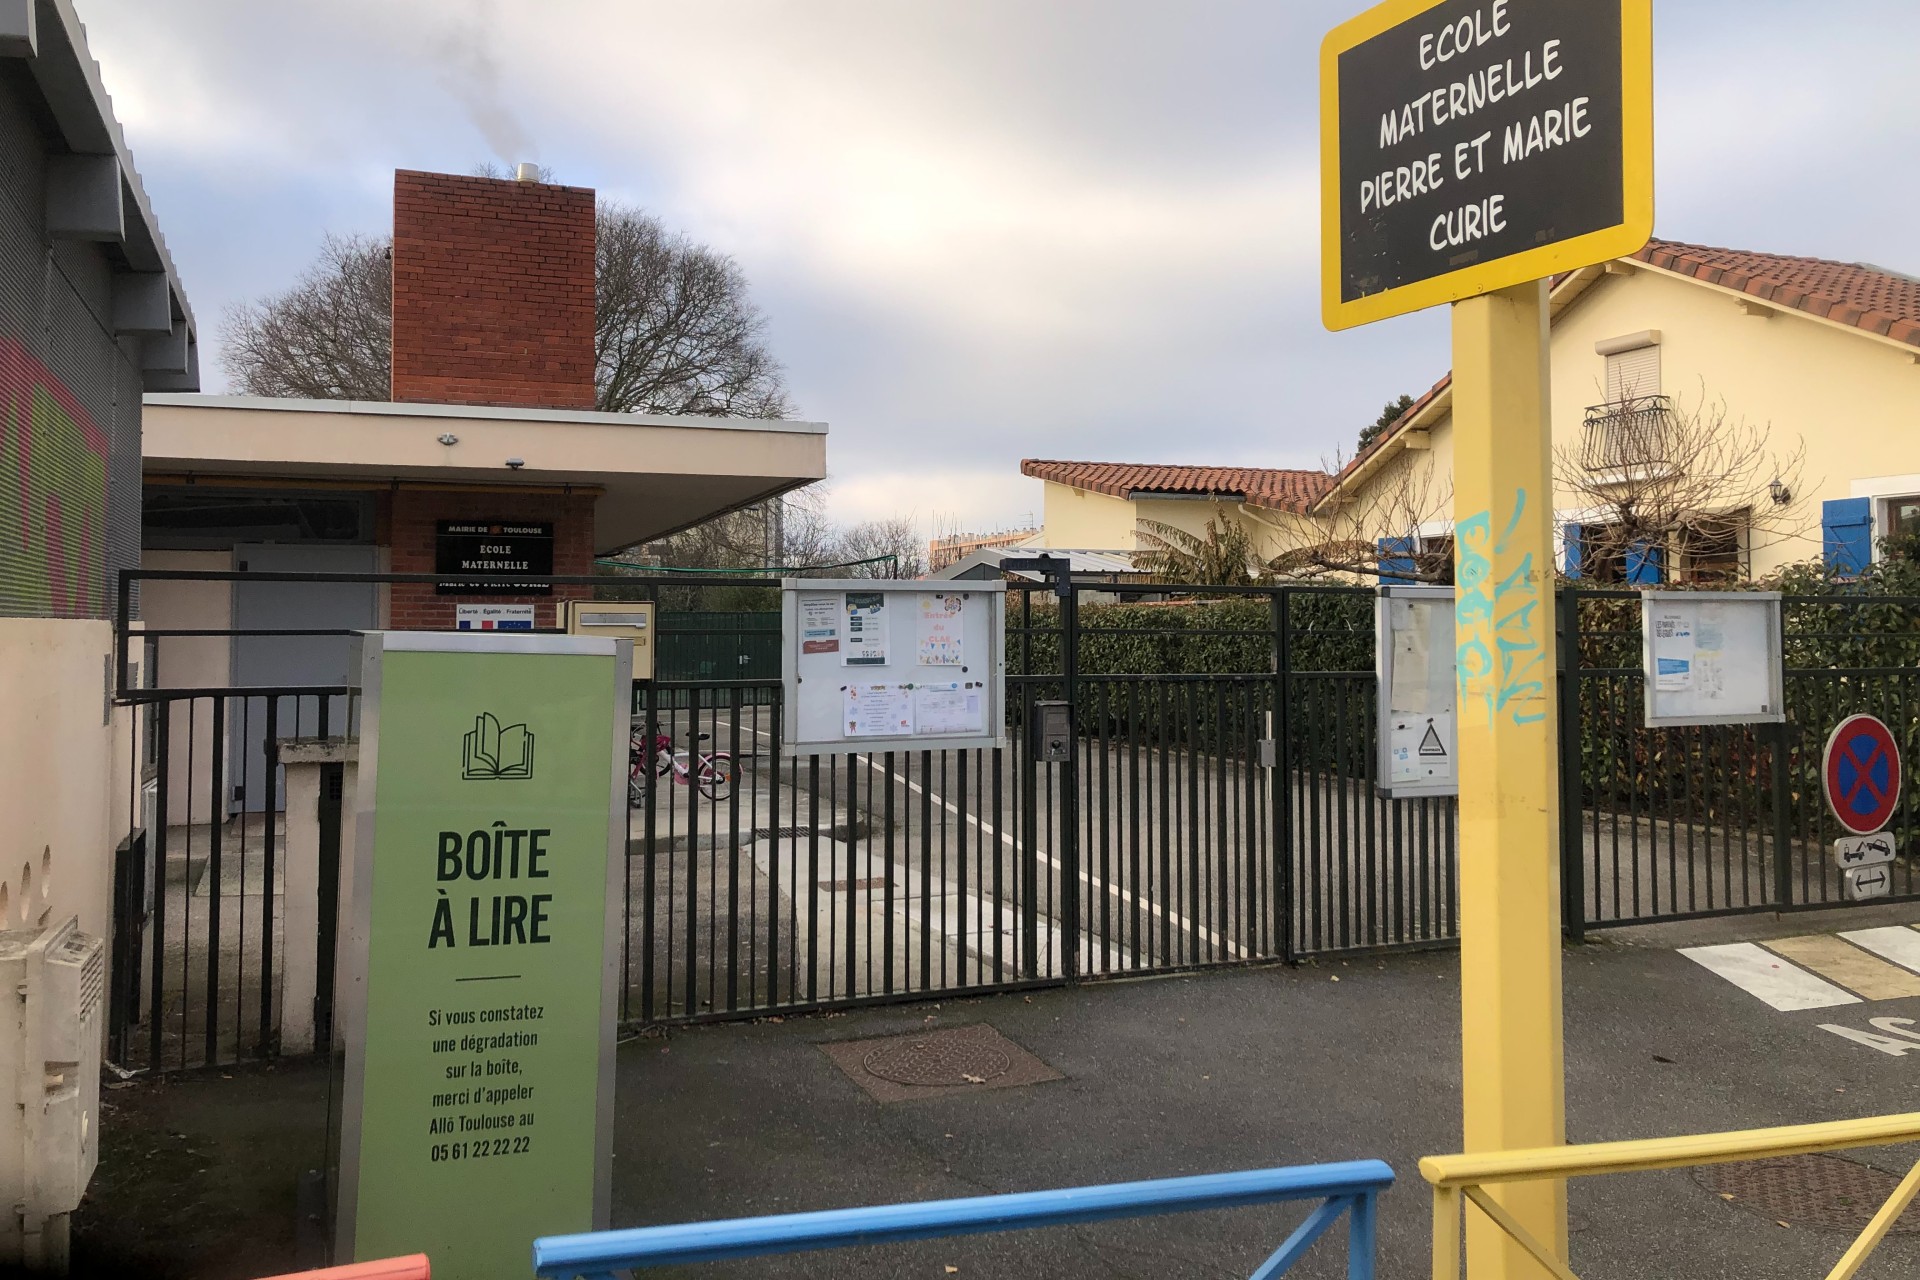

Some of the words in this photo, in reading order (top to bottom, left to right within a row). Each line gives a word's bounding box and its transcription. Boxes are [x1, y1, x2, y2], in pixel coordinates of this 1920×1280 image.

[1419, 0, 1511, 70] ECOLE
[1380, 39, 1562, 148] MATERNELLE
[1360, 153, 1443, 214] PIERRE
[1455, 132, 1492, 180] ET
[1504, 97, 1592, 164] MARIE
[1430, 194, 1506, 251] CURIE
[480, 545, 512, 554] ECOLE
[462, 560, 529, 570] MATERNELLE
[436, 820, 550, 882] BOÎTE
[428, 888, 456, 948] À
[469, 894, 552, 946] LIRE
[429, 1009, 441, 1026] Si
[446, 1012, 475, 1025] vous
[480, 1005, 544, 1022] constatez
[433, 1039, 456, 1052] une
[461, 1031, 538, 1053] dégradation
[446, 1064, 467, 1078] sur
[471, 1061, 481, 1076] la
[487, 1059, 522, 1076] boîte,
[433, 1088, 469, 1107] merci
[474, 1084, 534, 1105] d'appeler
[429, 1116, 454, 1135] Allô
[459, 1114, 514, 1132] Toulouse
[519, 1112, 534, 1126] au
[431, 1144, 448, 1162] 05
[452, 1142, 468, 1160] 61
[472, 1140, 490, 1158] 22
[493, 1138, 510, 1156] 22
[513, 1136, 530, 1153] 22
